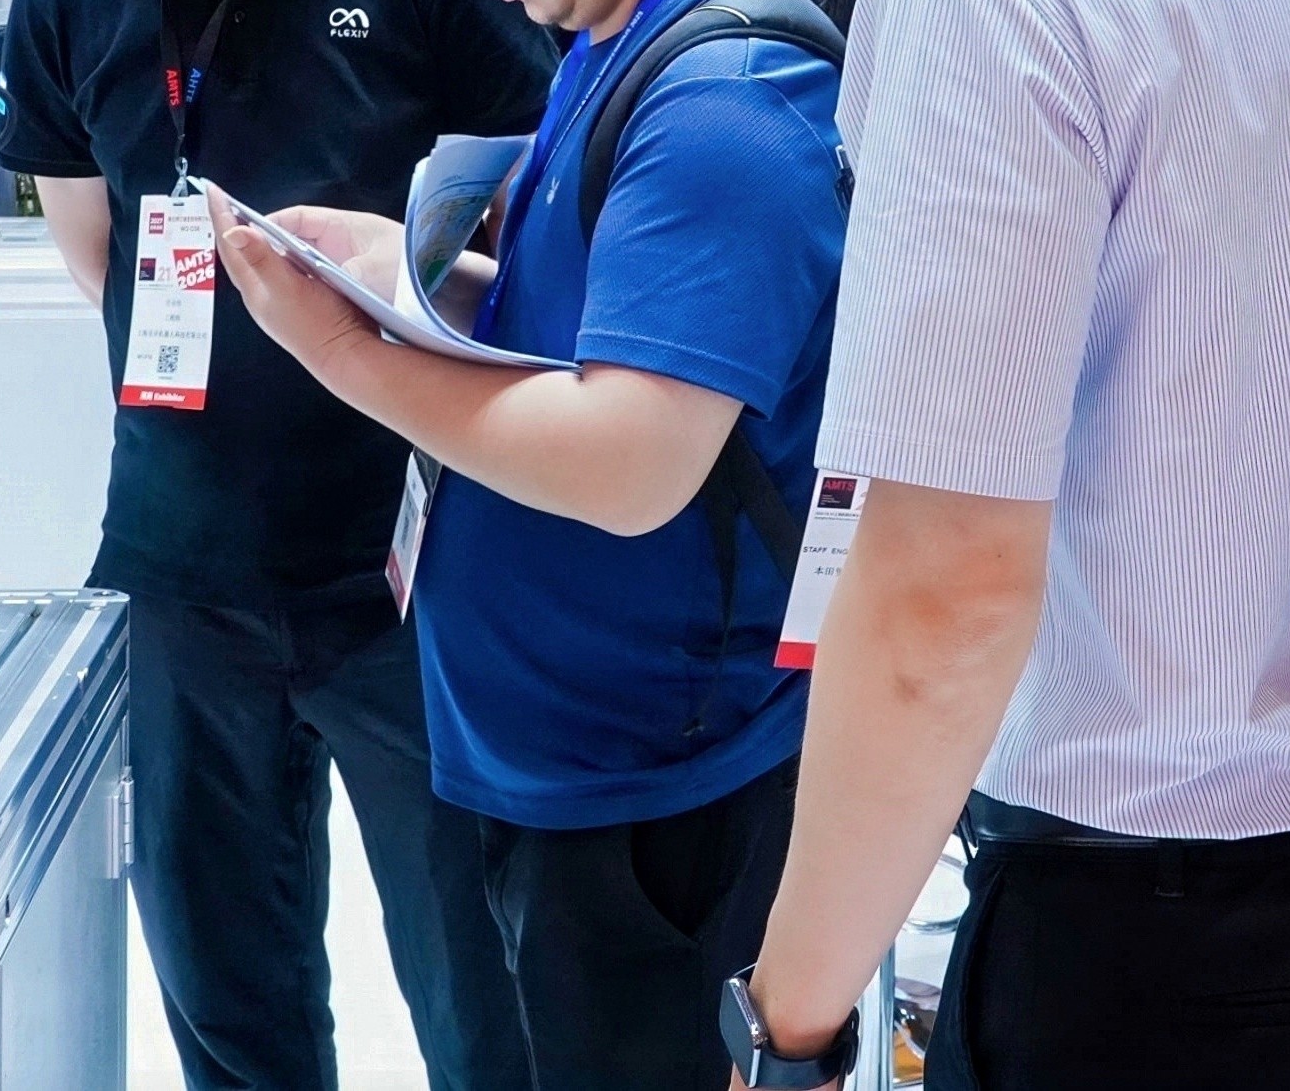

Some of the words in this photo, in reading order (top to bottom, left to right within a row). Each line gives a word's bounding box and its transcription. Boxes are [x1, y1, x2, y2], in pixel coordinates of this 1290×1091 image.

[330, 28, 369, 38] FLEXIV
[166, 70, 179, 105] AMTS
[186, 68, 201, 103] AHTE
[176, 249, 213, 273] AMTS
[178, 263, 215, 289] 2026
[823, 480, 854, 491] AMTS
[803, 546, 827, 554] STAFF
